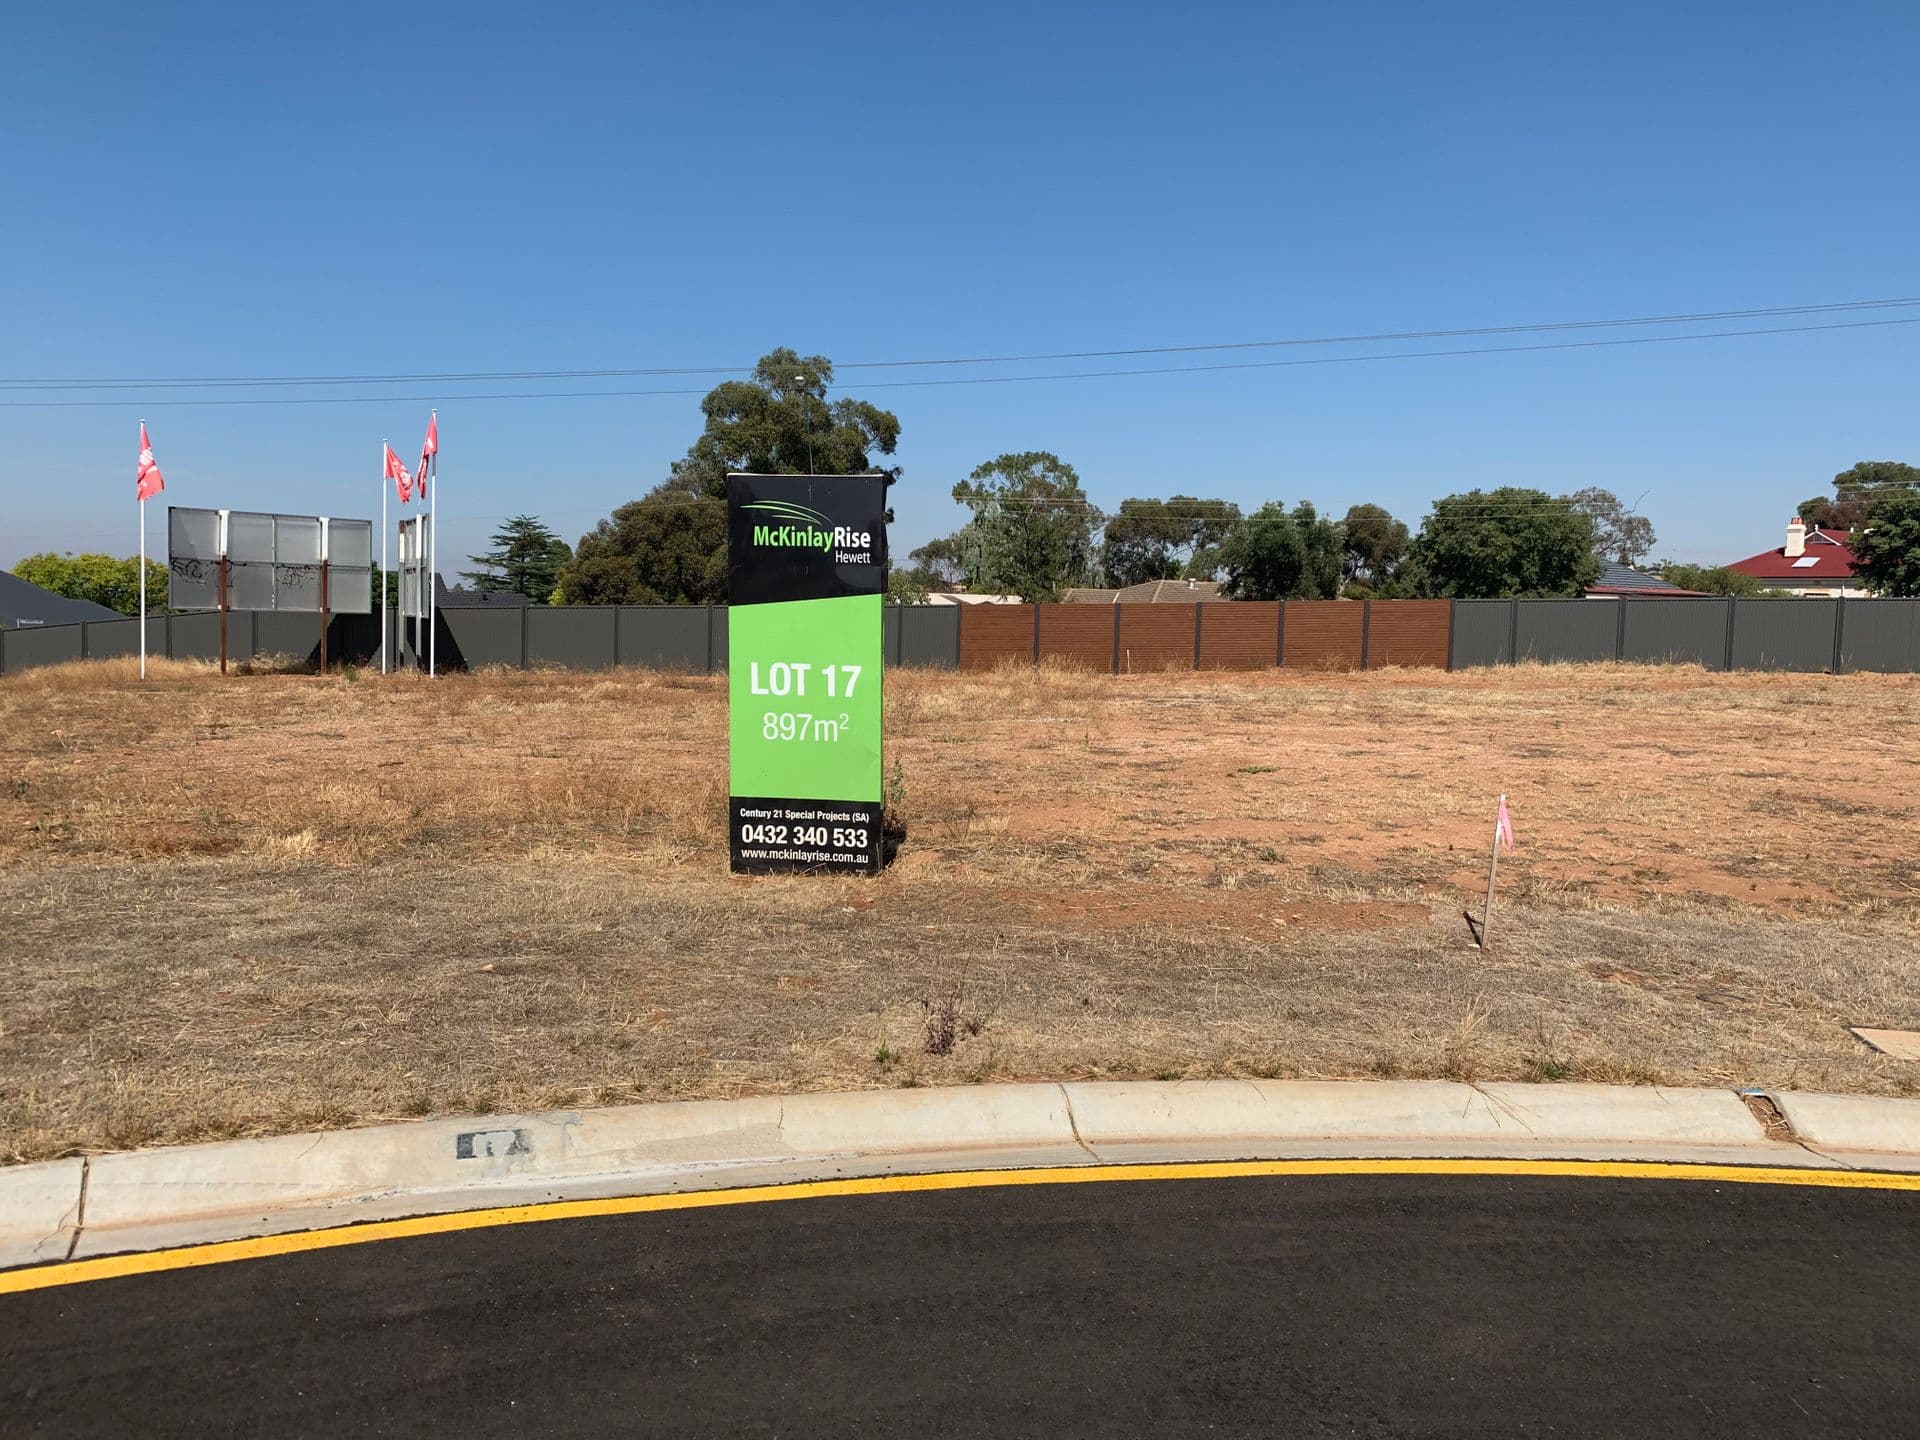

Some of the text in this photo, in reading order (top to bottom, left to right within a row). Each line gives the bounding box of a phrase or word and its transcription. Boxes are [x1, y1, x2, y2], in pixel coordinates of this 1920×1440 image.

[754, 525, 871, 552] McKinlayRise
[836, 550, 870, 564] Hewett
[750, 662, 862, 698] LOT 17
[740, 808, 870, 824] Century 21 Special Projects (SA)
[741, 824, 868, 848] 0432 340 533
[741, 849, 868, 864] www.mckinlayrise.com.au
